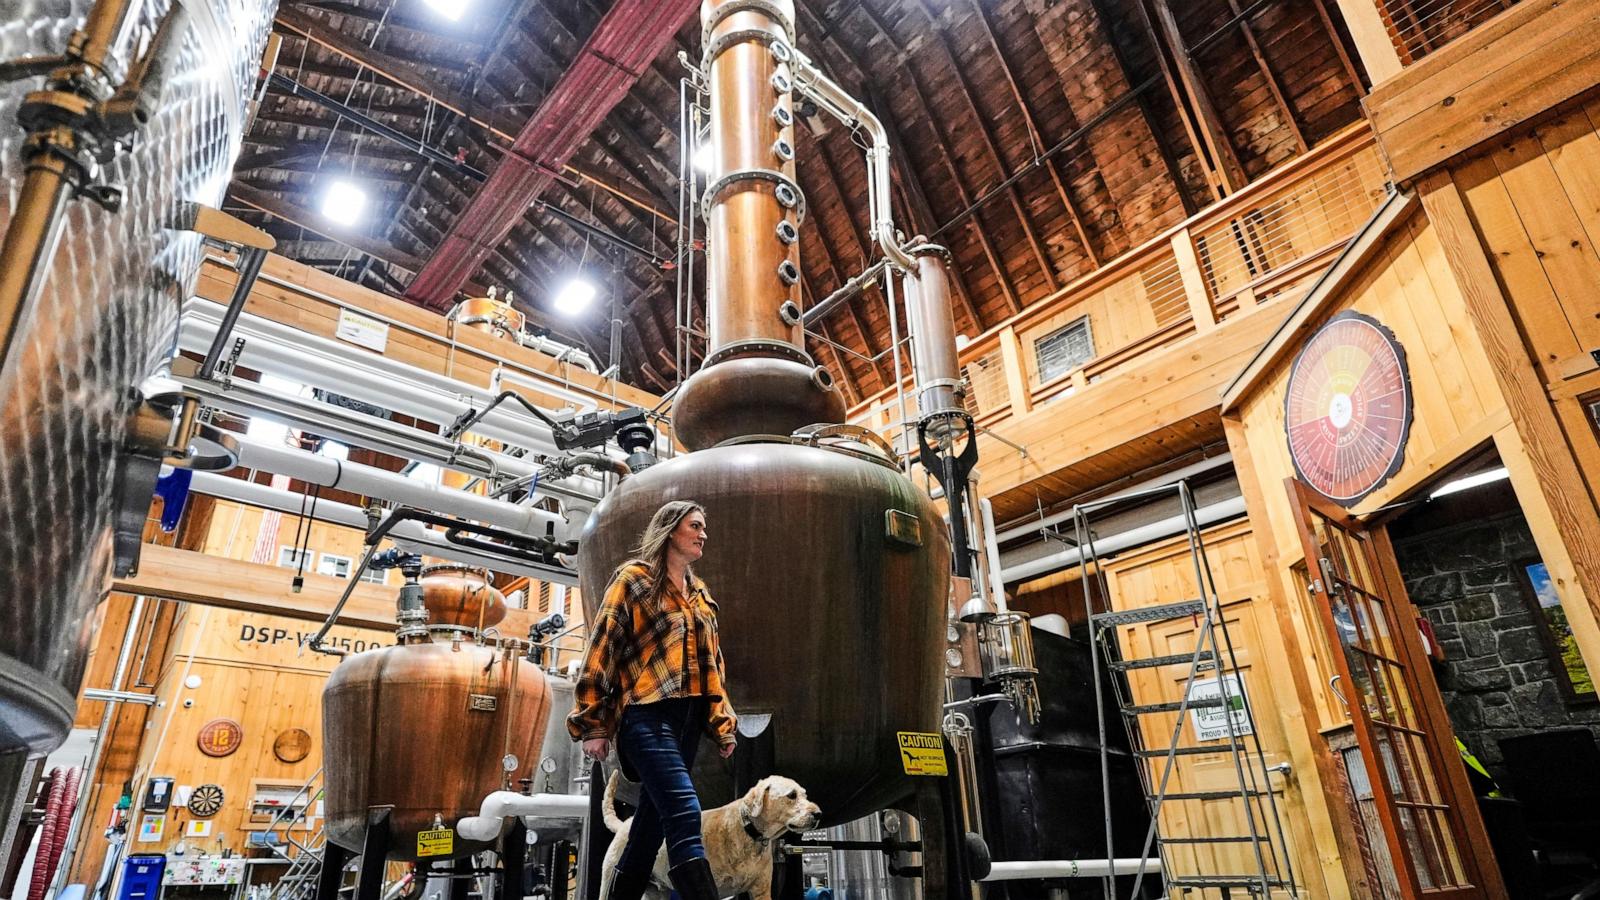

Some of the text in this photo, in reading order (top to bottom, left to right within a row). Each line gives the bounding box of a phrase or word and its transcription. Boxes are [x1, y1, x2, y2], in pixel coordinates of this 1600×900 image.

[240, 624, 394, 653] DSP-V-150
[1201, 726, 1250, 738] PROUD MMER
[901, 735, 942, 748] CAUTION
[420, 831, 451, 840] CAUTION
